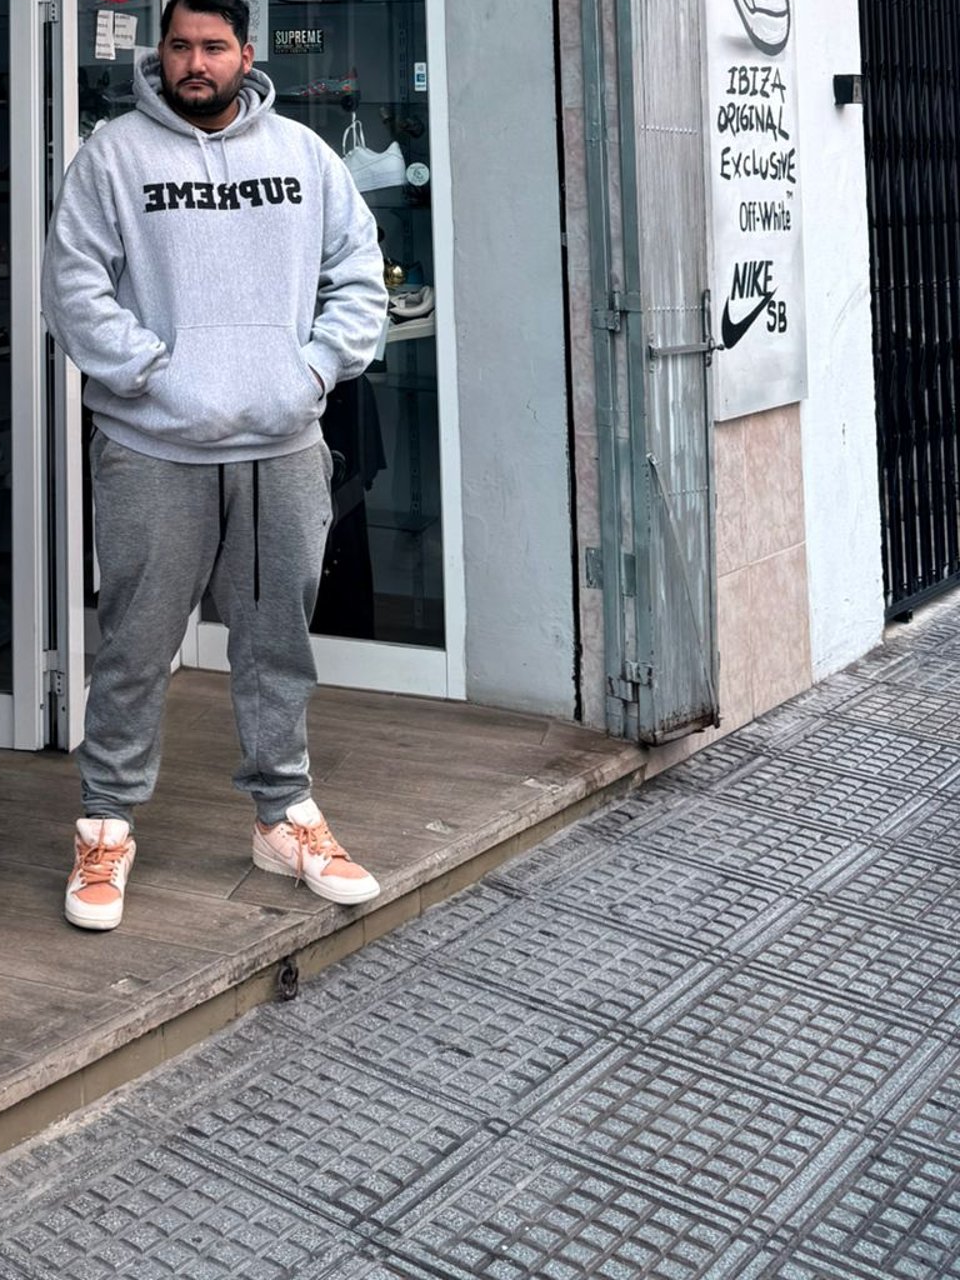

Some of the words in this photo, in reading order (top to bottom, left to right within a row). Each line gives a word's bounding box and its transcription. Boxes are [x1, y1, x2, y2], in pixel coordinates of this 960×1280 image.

[275, 29, 323, 45] SUPREME
[726, 65, 787, 104] IBIZA
[716, 102, 790, 142] ORIGINAL
[720, 147, 797, 184] EXCLUSIVE
[739, 201, 792, 232] Off-White
[731, 260, 774, 301] NIKE
[766, 300, 788, 333] SB
